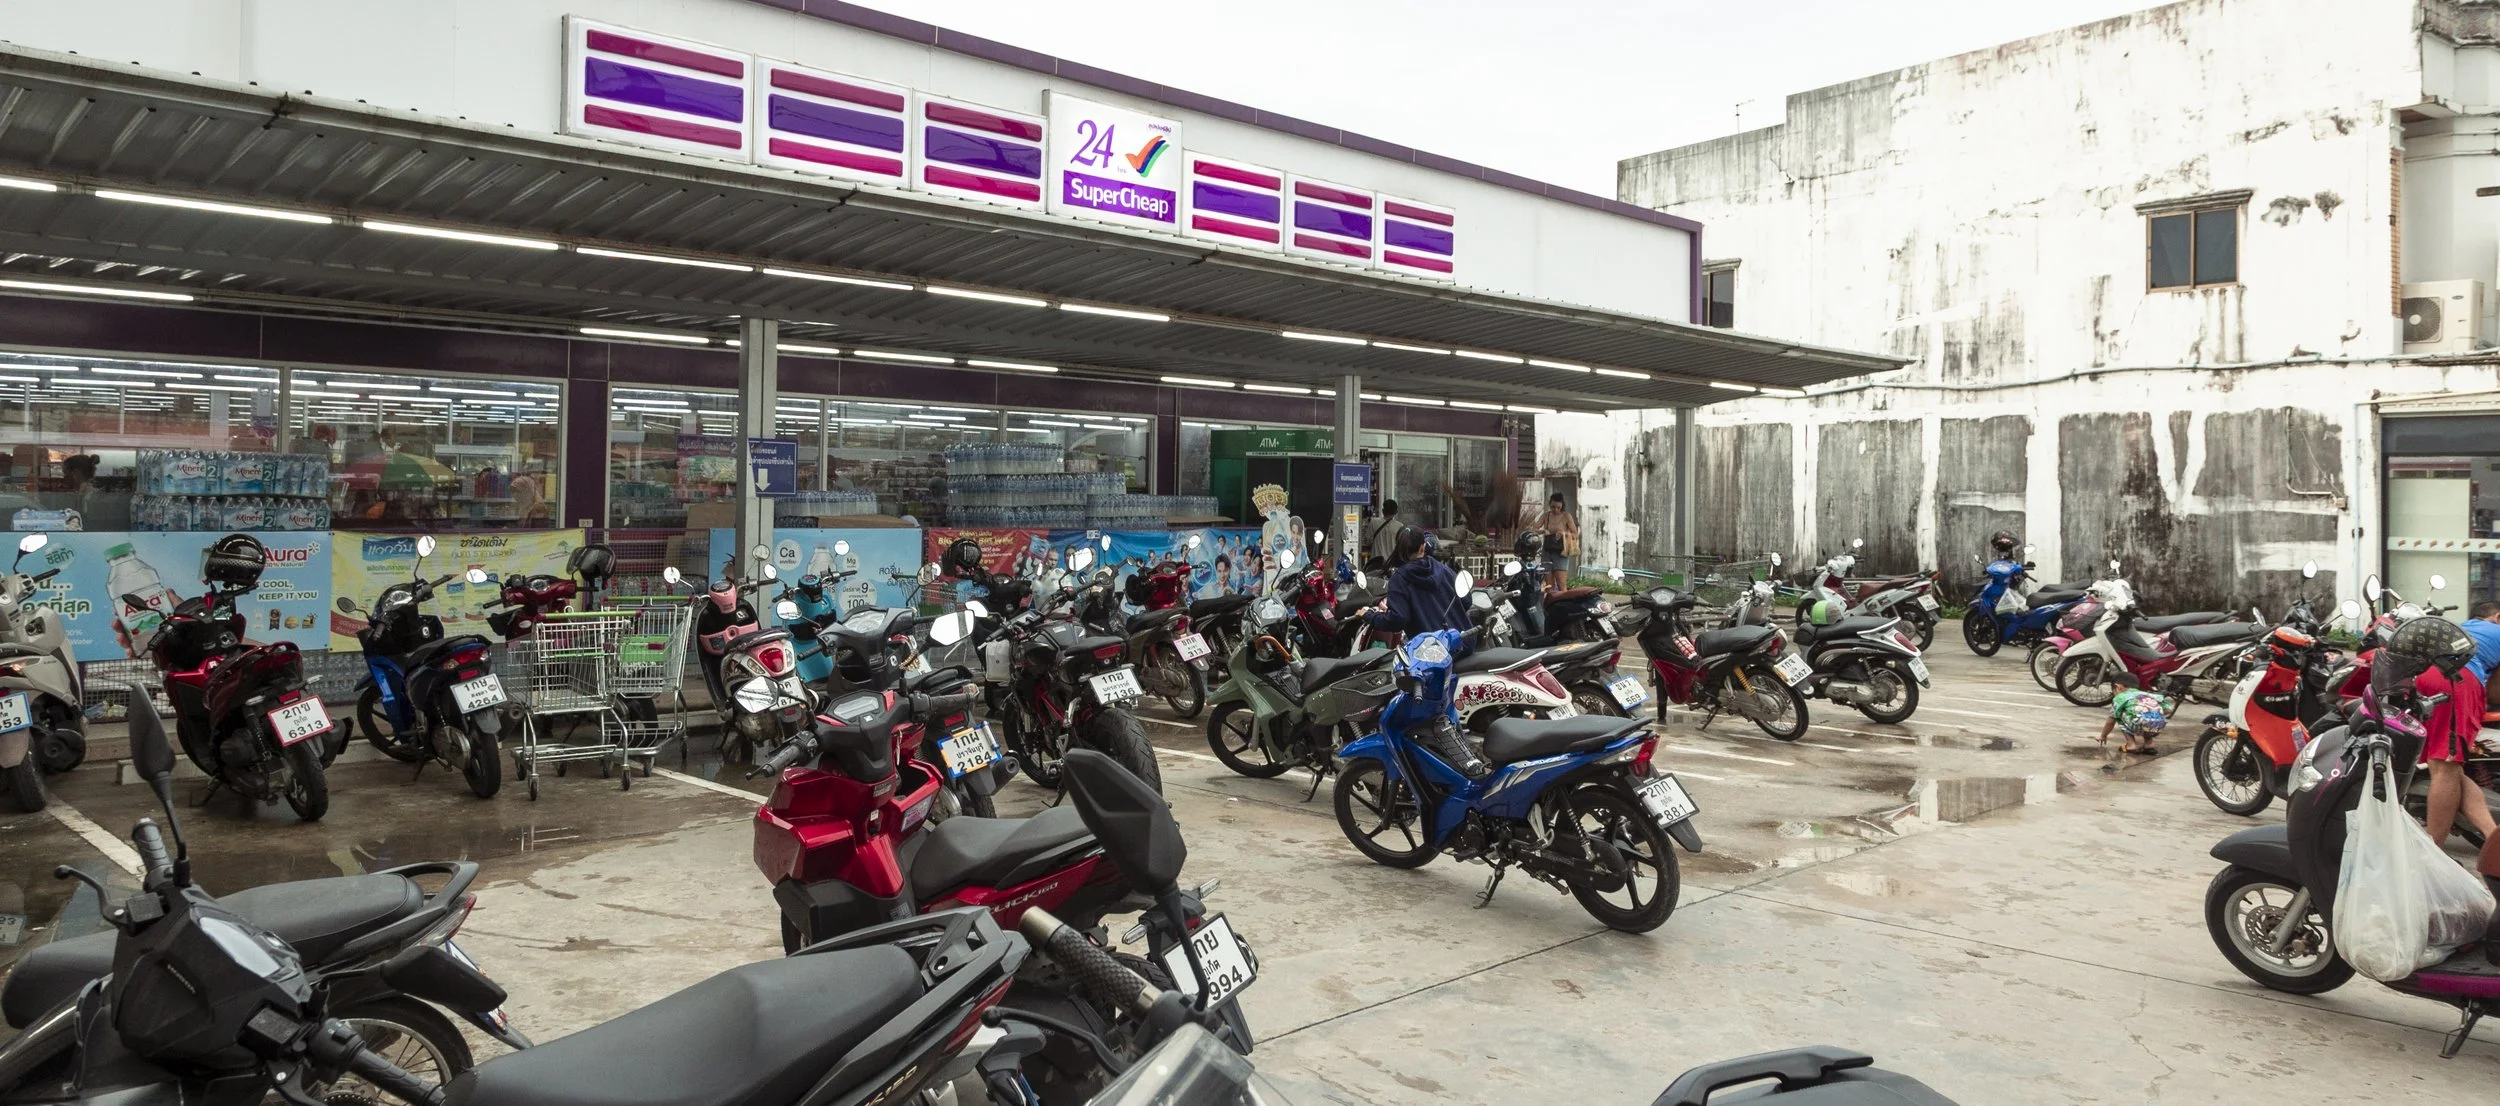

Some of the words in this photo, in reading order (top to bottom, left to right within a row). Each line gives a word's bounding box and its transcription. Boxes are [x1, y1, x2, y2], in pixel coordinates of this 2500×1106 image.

[1070, 120, 1115, 169] 24
[1071, 178, 1169, 218] SuperCheap
[206, 465, 216, 478] 2
[263, 471, 272, 482] 2
[264, 547, 307, 562] Aura
[780, 547, 795, 558] Ca
[846, 558, 857, 566] Mg
[861, 582, 869, 594] 9
[258, 593, 283, 601] KEEP
[125, 596, 161, 617] Ara
[1104, 688, 1136, 702] 7136
[288, 719, 324, 739] 6313
[957, 751, 992, 771] 2184
[1646, 780, 1672, 798] 2กก
[1663, 804, 1687, 821] 881
[992, 881, 1059, 913] LICK160
[1208, 965, 1243, 1001] 994
